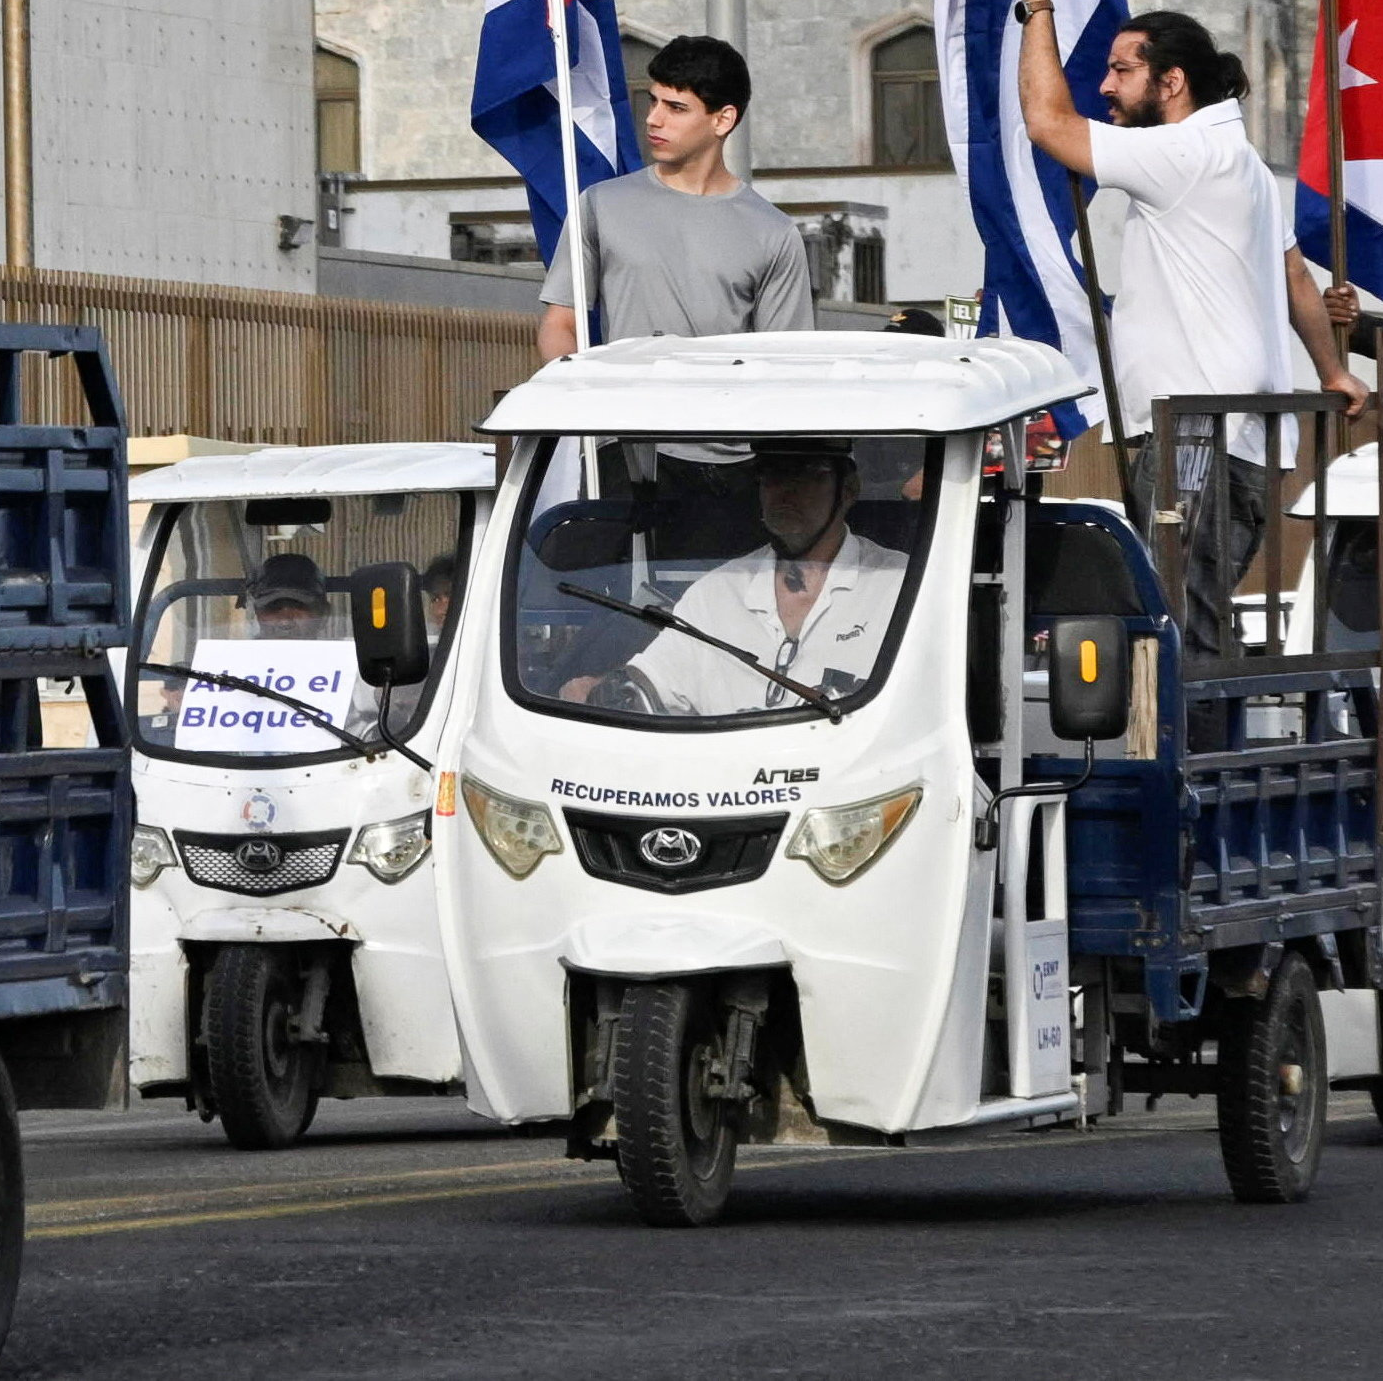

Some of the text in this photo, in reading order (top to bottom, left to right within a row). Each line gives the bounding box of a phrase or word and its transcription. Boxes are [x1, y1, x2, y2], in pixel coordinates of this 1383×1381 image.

[308, 670, 342, 693] el
[182, 705, 334, 733] Bloqueo
[550, 778, 802, 808] RECUPERAMOS VALORES
